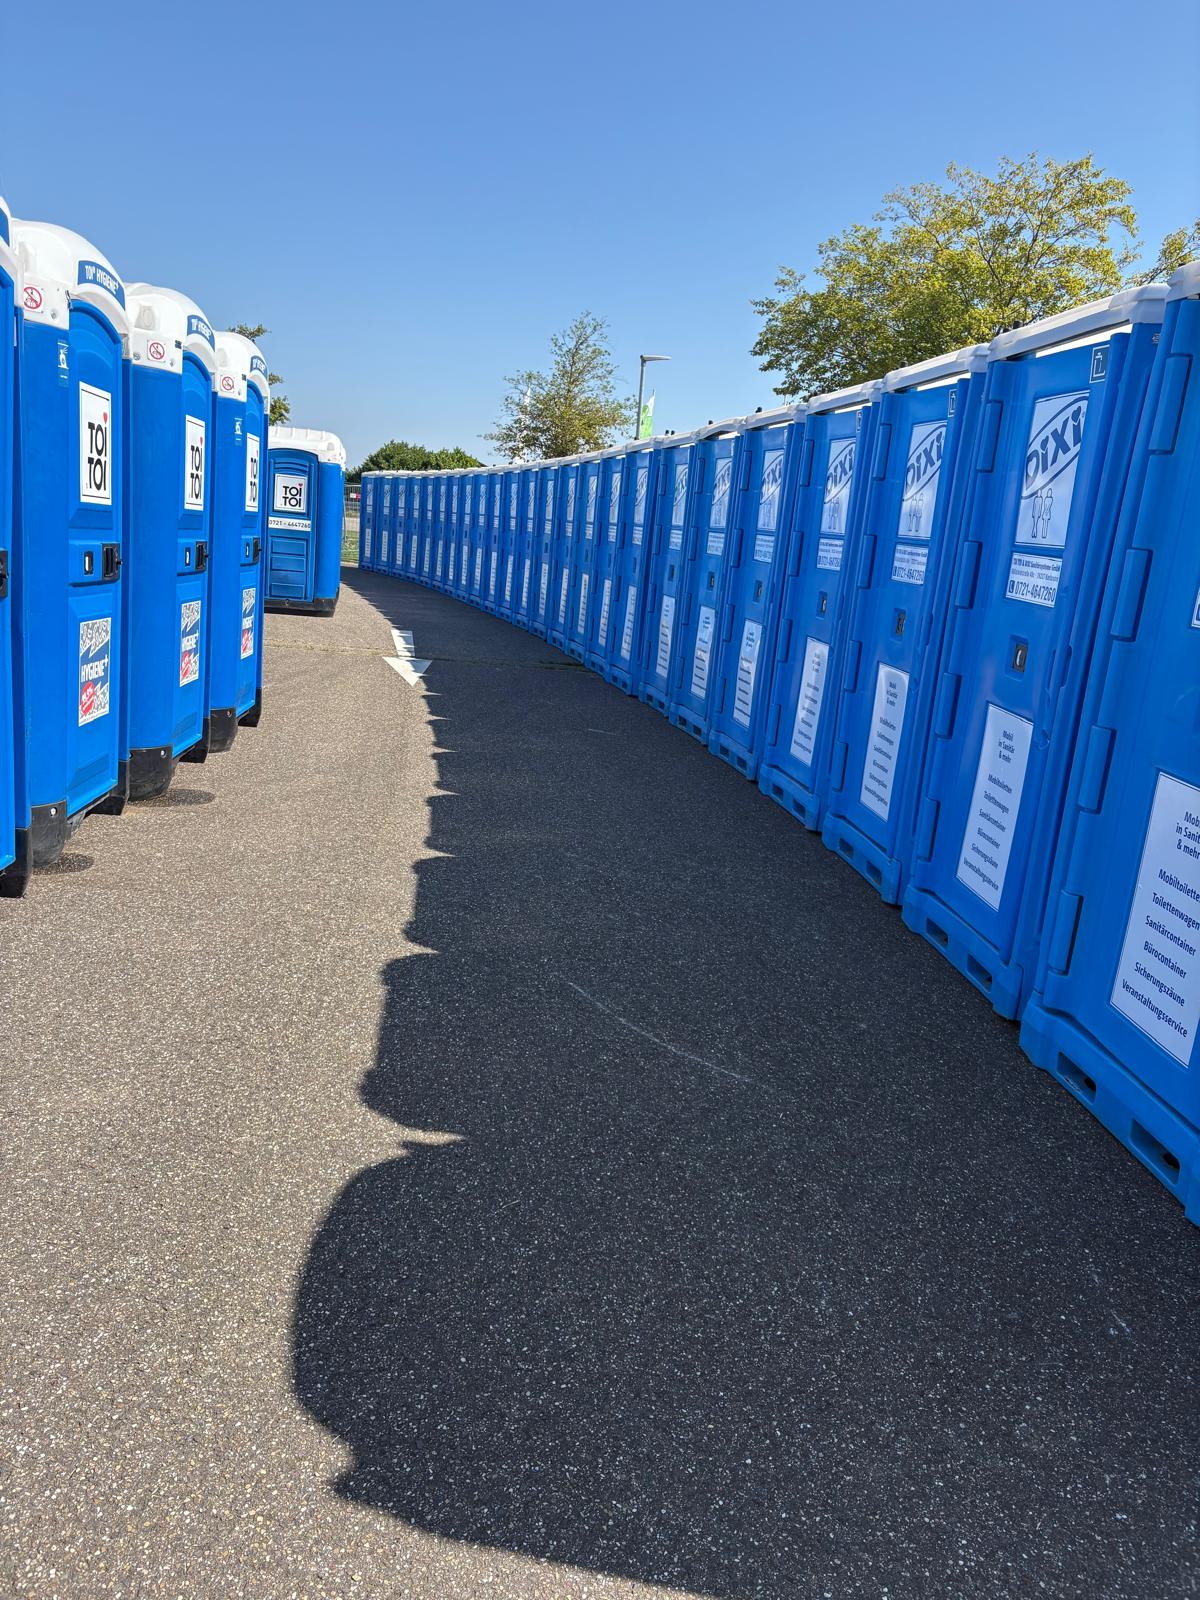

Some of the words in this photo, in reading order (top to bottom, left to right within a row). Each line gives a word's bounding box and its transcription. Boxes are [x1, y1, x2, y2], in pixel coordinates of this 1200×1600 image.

[88, 421, 107, 457] TOI
[88, 457, 107, 491] TOI
[190, 445, 203, 473] TOI
[190, 473, 202, 499] TOI
[282, 485, 302, 497] TOI
[282, 496, 302, 508] TOI
[1176, 822, 1183, 835] in
[1184, 811, 1200, 828] Mob
[1176, 838, 1182, 850] &
[1158, 868, 1200, 903] Mobiltoilette
[1152, 891, 1200, 931] Toilettenwagen
[1145, 914, 1197, 957] Sanitärcontainer
[1143, 940, 1187, 979] Bürocontainer
[1134, 961, 1185, 1007] Sicherungszäune
[1122, 978, 1188, 1038] Veranstaltungsservice
